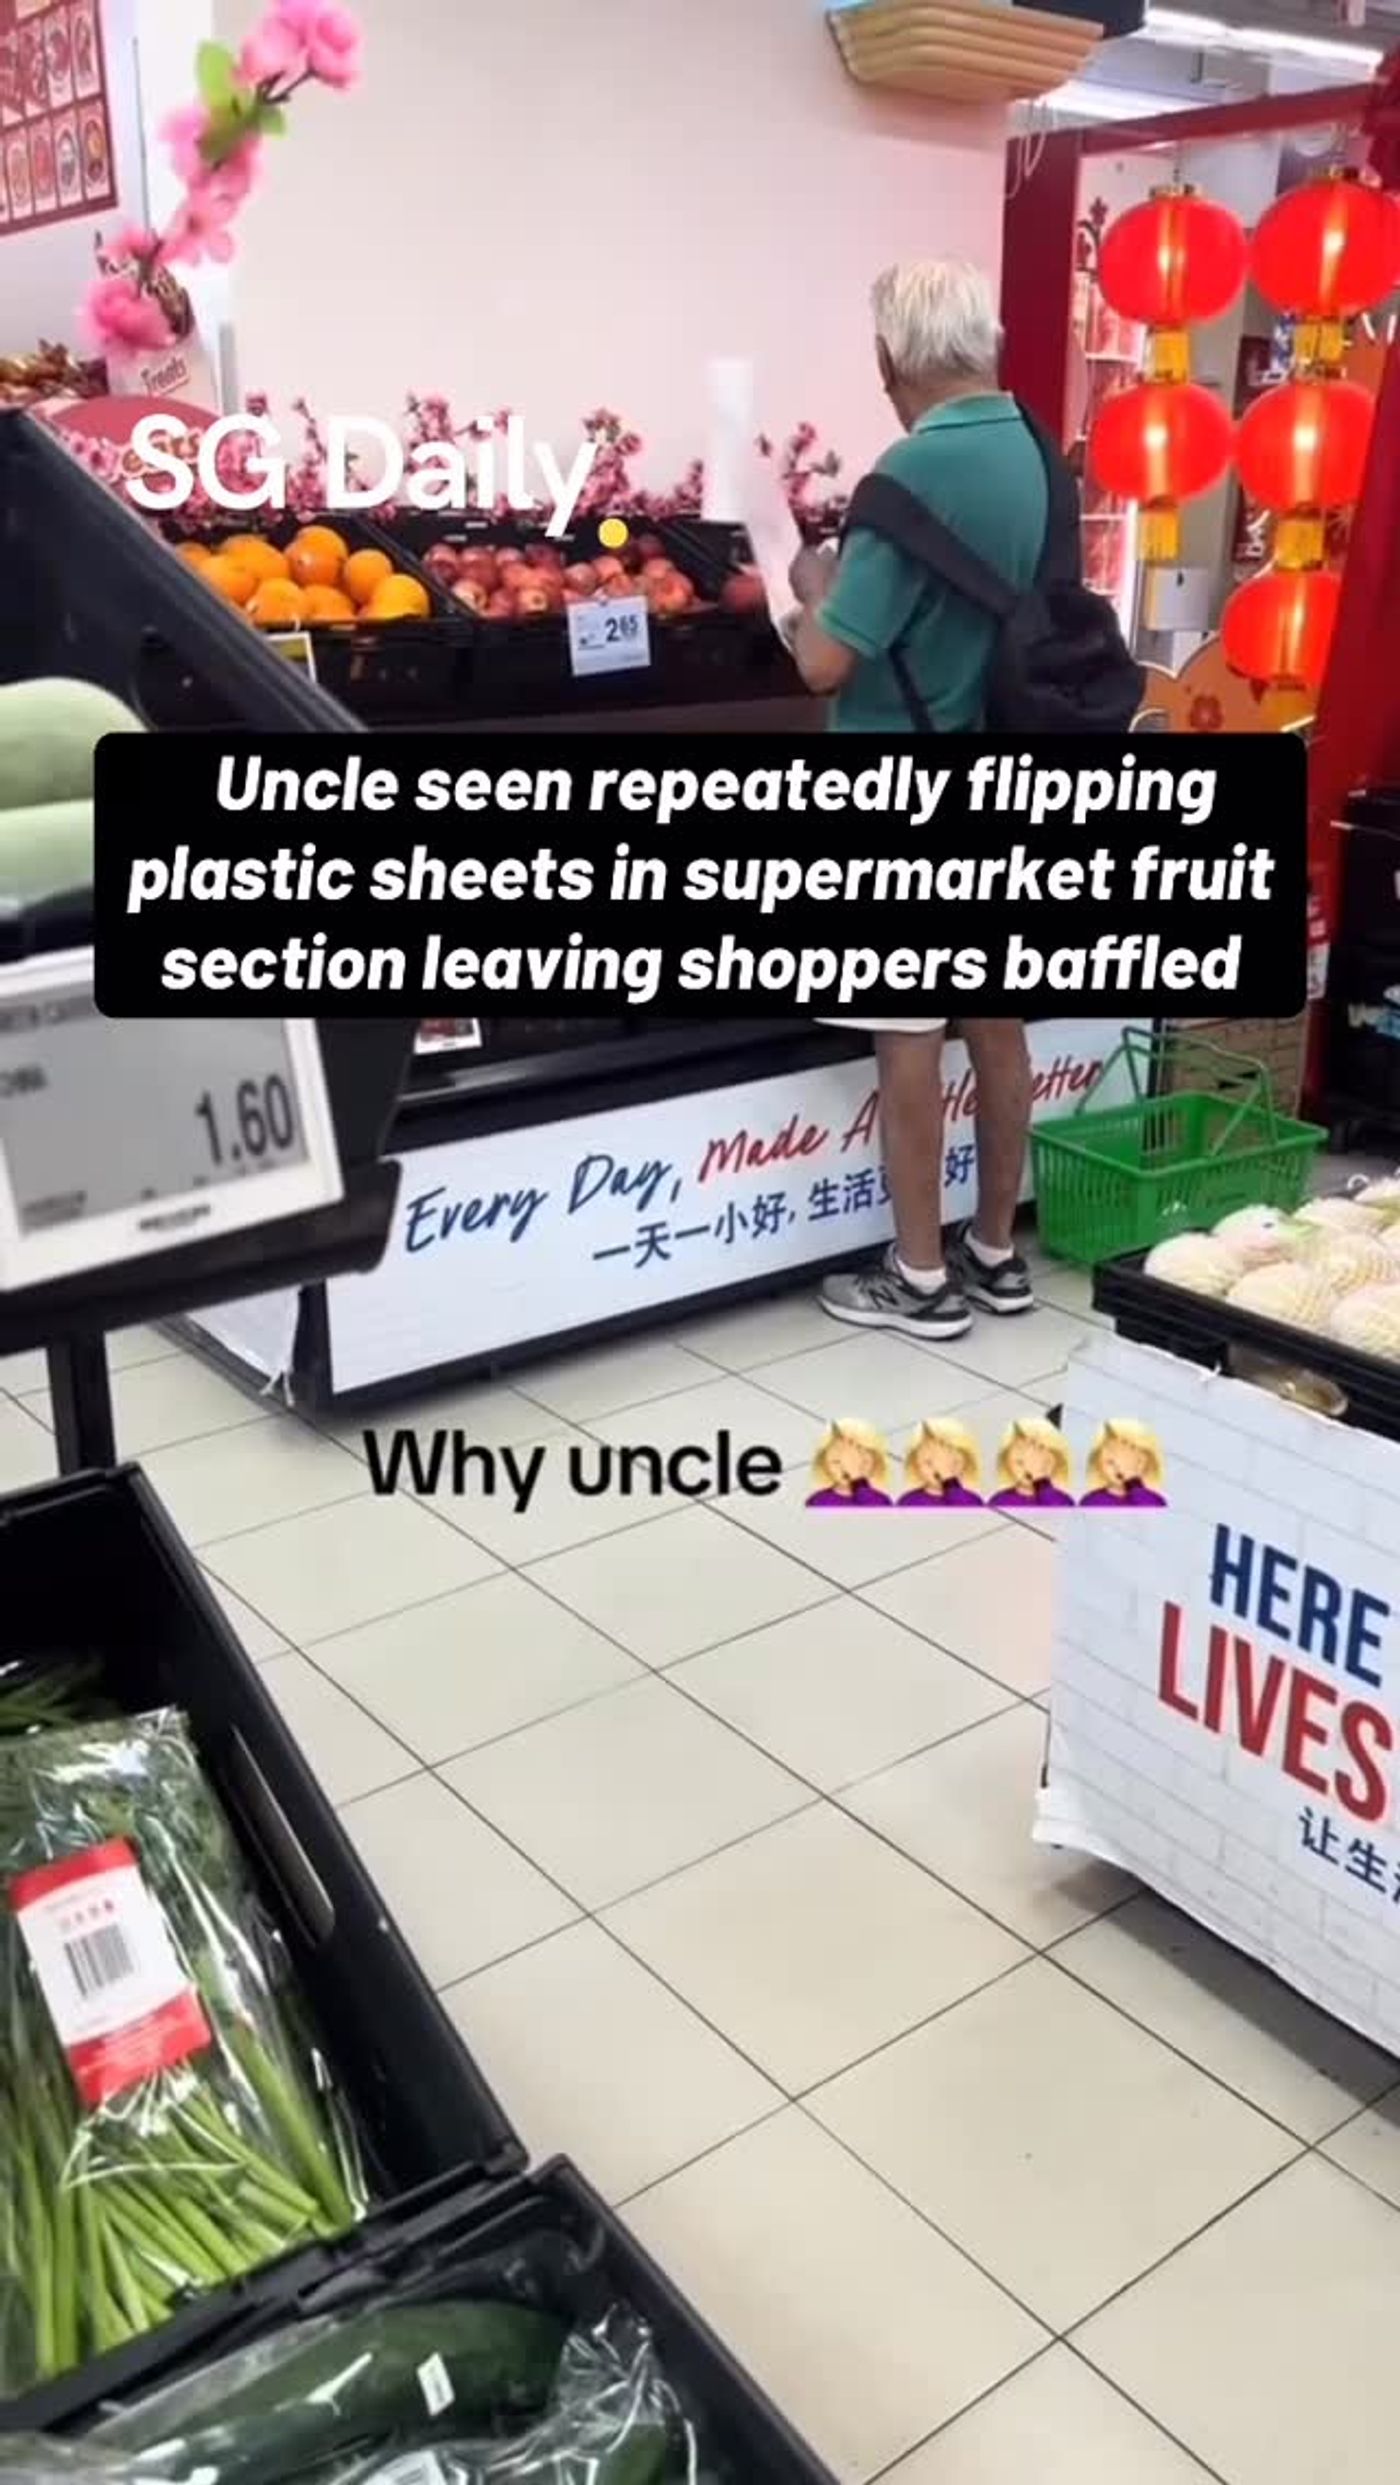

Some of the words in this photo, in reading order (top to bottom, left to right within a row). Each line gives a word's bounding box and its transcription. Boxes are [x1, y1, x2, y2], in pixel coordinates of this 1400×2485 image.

[195, 1071, 293, 1166] 1.60
[405, 1185, 549, 1252] Every
[567, 1153, 682, 1214] Day,
[698, 1114, 829, 1182] Made
[841, 1088, 880, 1152] A
[1031, 1053, 1106, 1101] etter
[1210, 1523, 1391, 1688] HERE
[1157, 1600, 1393, 1822] LIVES
[1298, 1805, 1400, 1903] 让生
